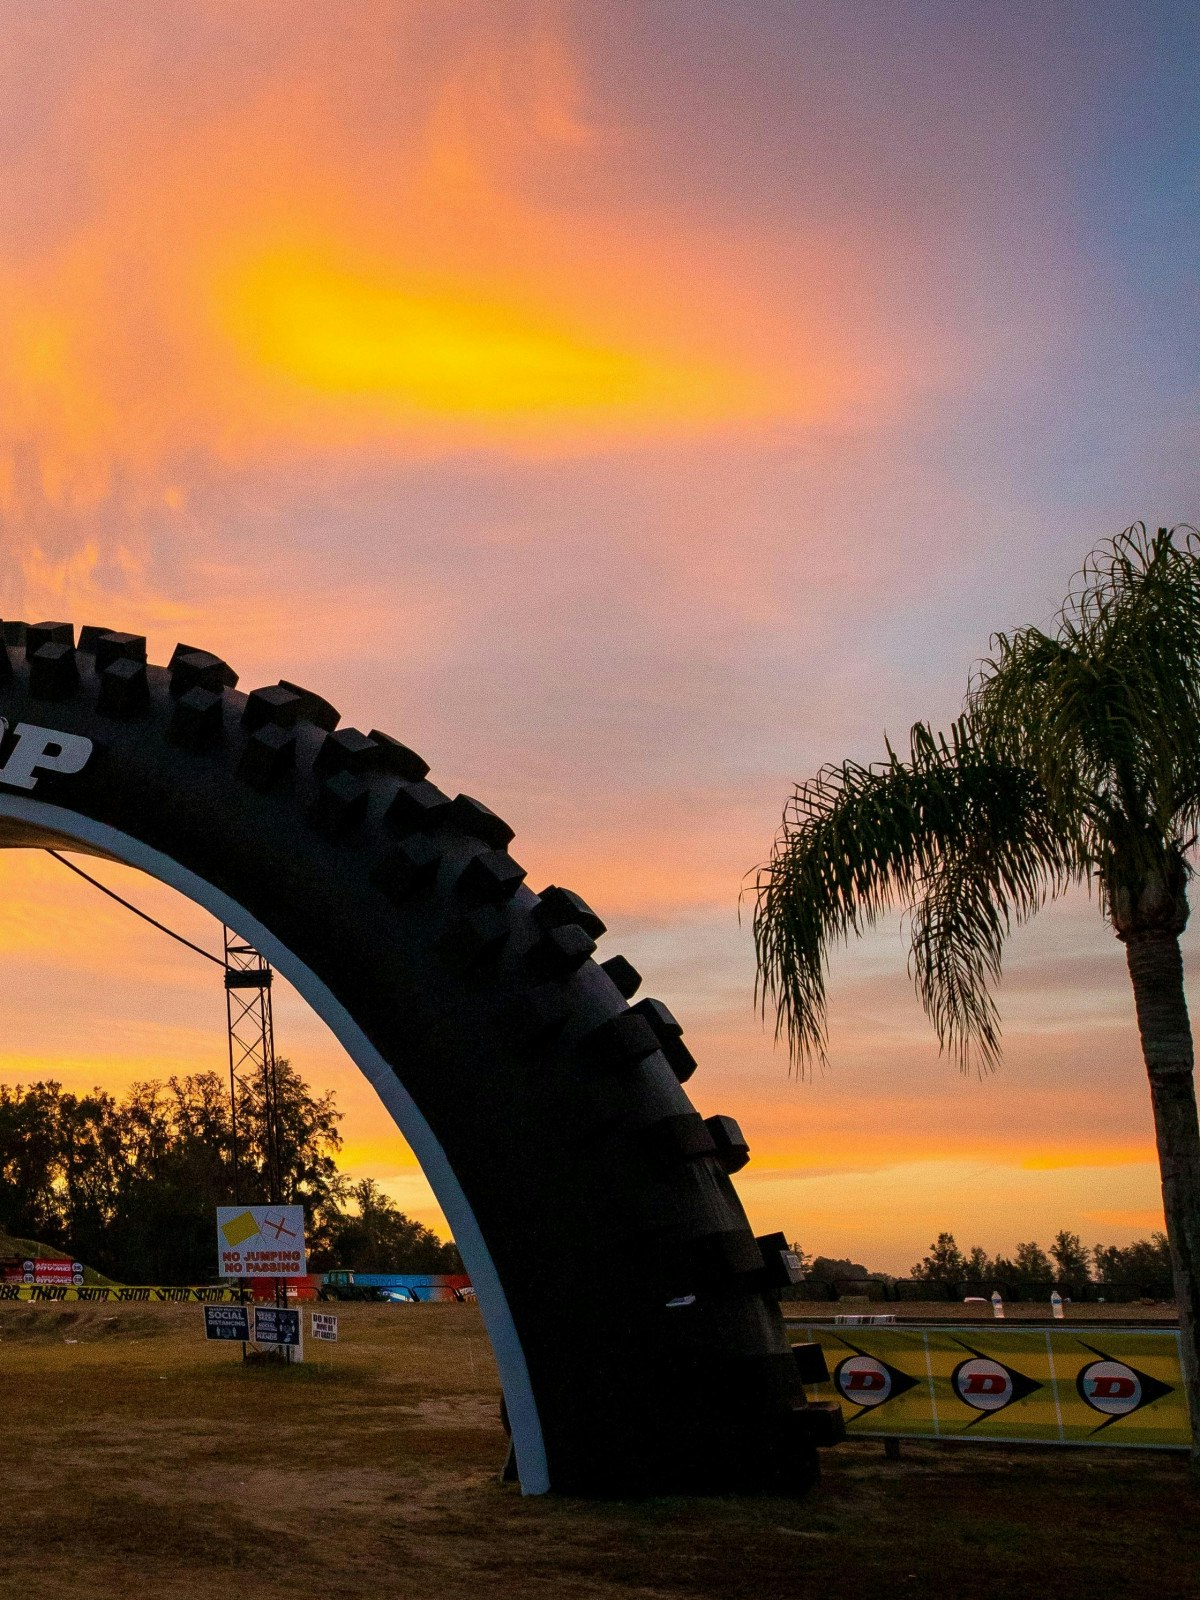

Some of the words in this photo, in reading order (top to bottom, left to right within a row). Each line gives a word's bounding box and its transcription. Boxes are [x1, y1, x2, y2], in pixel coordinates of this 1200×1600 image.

[223, 1252, 240, 1261] NO
[243, 1251, 301, 1261] JUMPING
[225, 1263, 242, 1272] NO
[246, 1262, 300, 1272] PASSING
[208, 1311, 245, 1320] SOCIAL
[313, 1314, 322, 1322] DO
[323, 1316, 337, 1325] NOT
[845, 1371, 885, 1391] D
[964, 1374, 1007, 1394] D
[1089, 1376, 1136, 1398] D
